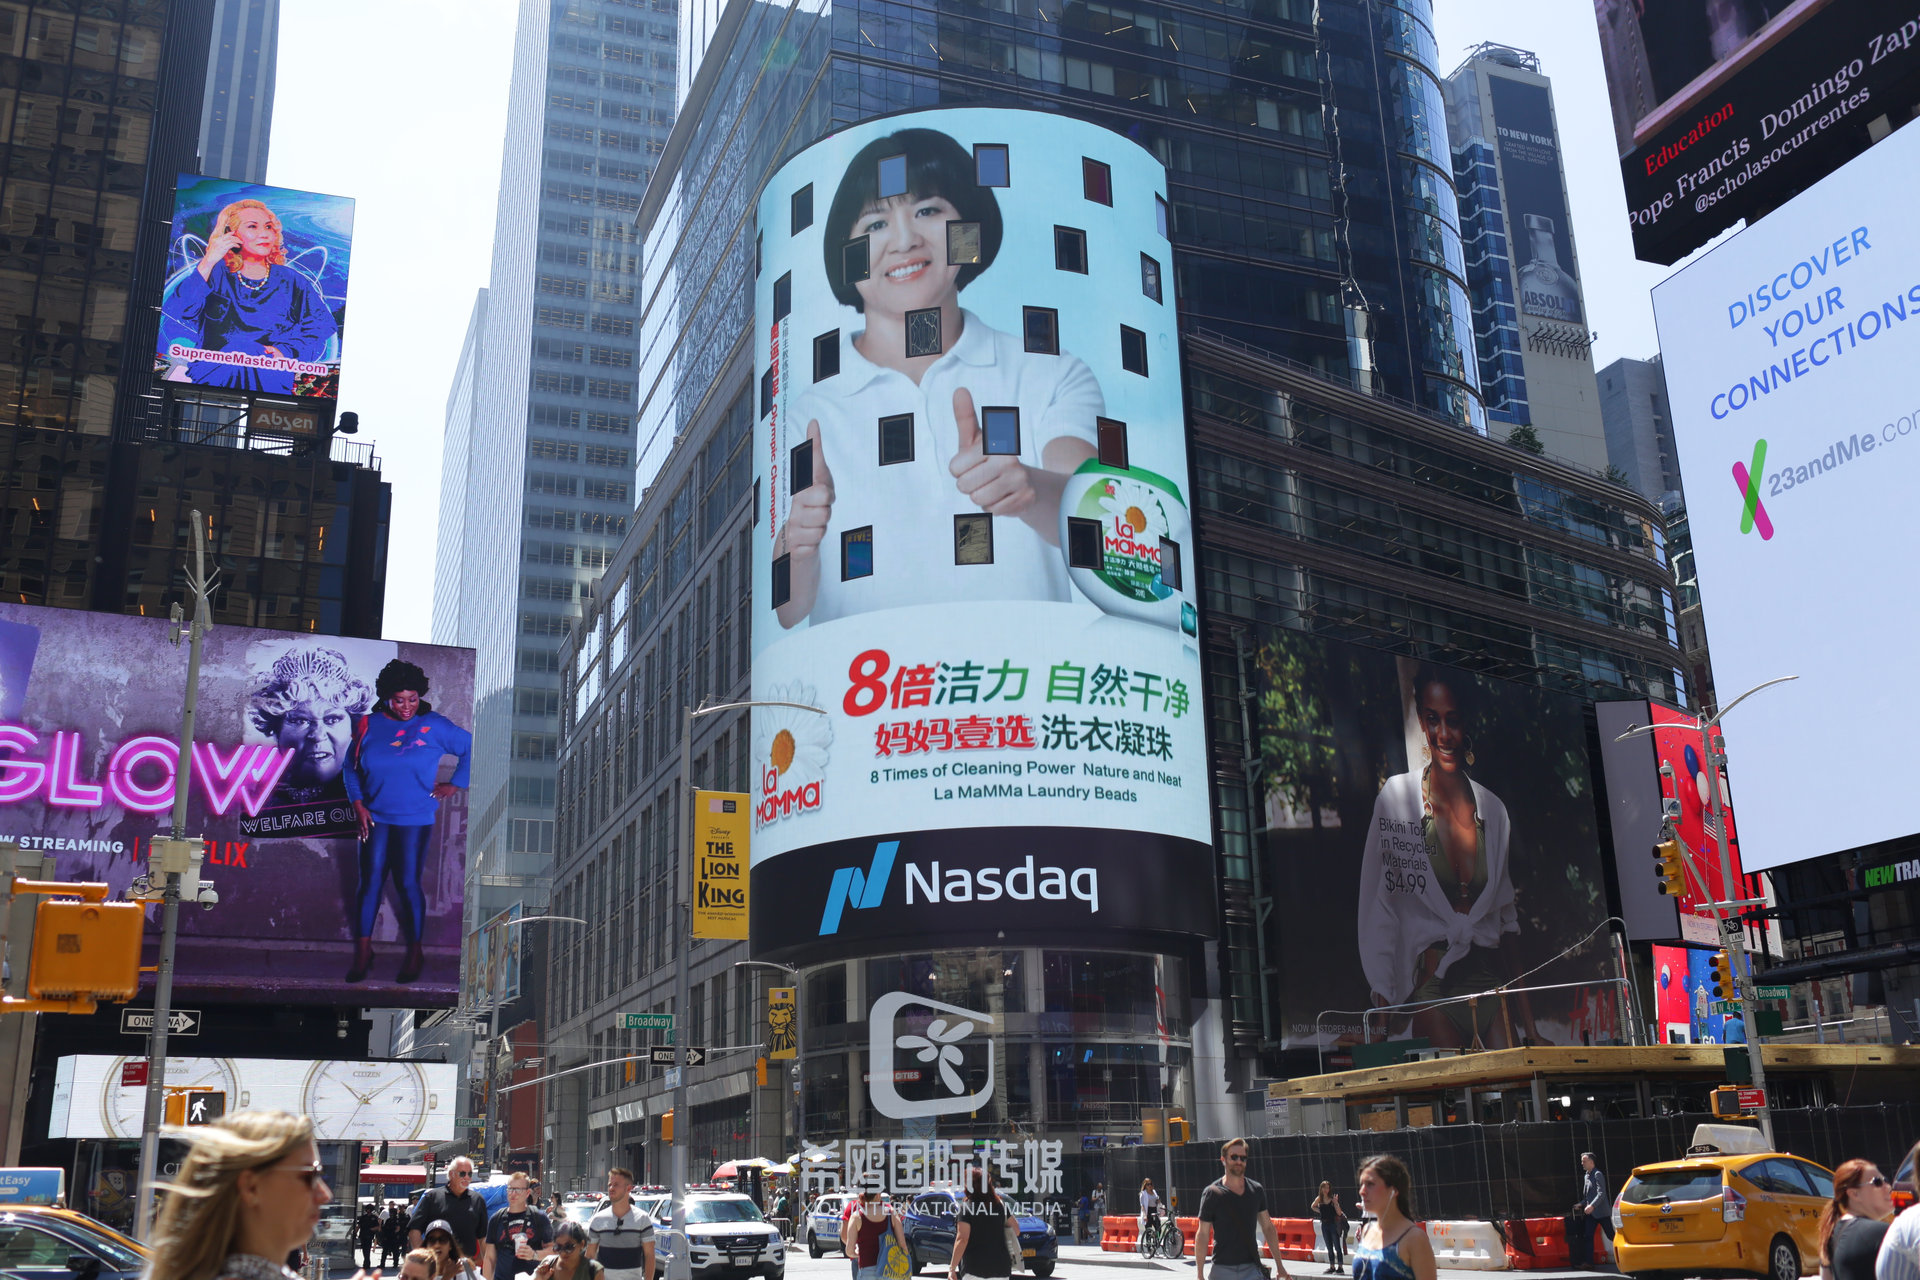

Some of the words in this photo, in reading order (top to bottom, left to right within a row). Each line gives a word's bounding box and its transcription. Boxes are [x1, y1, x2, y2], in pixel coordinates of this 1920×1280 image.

[1497, 126, 1508, 136] TO
[1509, 129, 1528, 141] NEW
[1630, 192, 1674, 232] Pope
[1676, 137, 1750, 199] Francis
[1760, 58, 1864, 140] Domingo
[1868, 15, 1920, 65] Zap
[1644, 101, 1735, 176] Education
[1695, 86, 1870, 213] @scholasocurrentes
[1728, 226, 1872, 329] DISCOVER
[1762, 286, 1845, 347] YOUR
[171, 346, 327, 374] SupremeMasterTV.com
[1710, 284, 1920, 420] CONNECTIONS
[256, 411, 313, 431] Absen
[770, 404, 778, 463] Olympic
[770, 465, 778, 539] Champion
[1046, 660, 1190, 719] 自然干净
[0, 725, 296, 816] GLOW
[870, 770, 879, 783] 8
[883, 767, 928, 782] Times
[932, 764, 948, 778] of
[952, 761, 1022, 777] Cleaning
[1027, 761, 1076, 776] Power
[1083, 763, 1130, 780] Nature
[1133, 767, 1155, 783] and
[1158, 771, 1182, 788] Neat
[934, 787, 953, 800] La
[958, 785, 1023, 799] MaMMa
[1028, 785, 1090, 802] Laundry
[1095, 786, 1137, 802] Beads
[240, 811, 326, 833] WELFARE
[330, 808, 357, 823] QU
[1379, 818, 1406, 834] Bikini
[1408, 822, 1427, 840] Top
[19, 836, 124, 854] STREAMING
[706, 841, 734, 855] THE
[1381, 835, 1390, 849] in
[1392, 837, 1437, 856] Recycled
[701, 857, 740, 880] LION
[1382, 852, 1427, 871] Materials
[698, 881, 745, 908] KING
[905, 855, 1099, 914] Nasdaq
[1385, 870, 1426, 895] $4.99
[1758, 988, 1788, 998] Broadway
[1718, 1003, 1724, 1012] W
[1727, 1002, 1735, 1011] 43
[133, 1017, 154, 1026] ONE
[628, 1015, 671, 1029] Broadway
[1292, 1024, 1309, 1033] NOW
[1311, 1024, 1318, 1033] IN
[1320, 1024, 1346, 1033] STORES
[1348, 1026, 1361, 1034] AND
[1364, 1026, 1387, 1035] NLINE
[658, 1052, 674, 1060] ONE
[895, 1071, 919, 1080] CITIES
